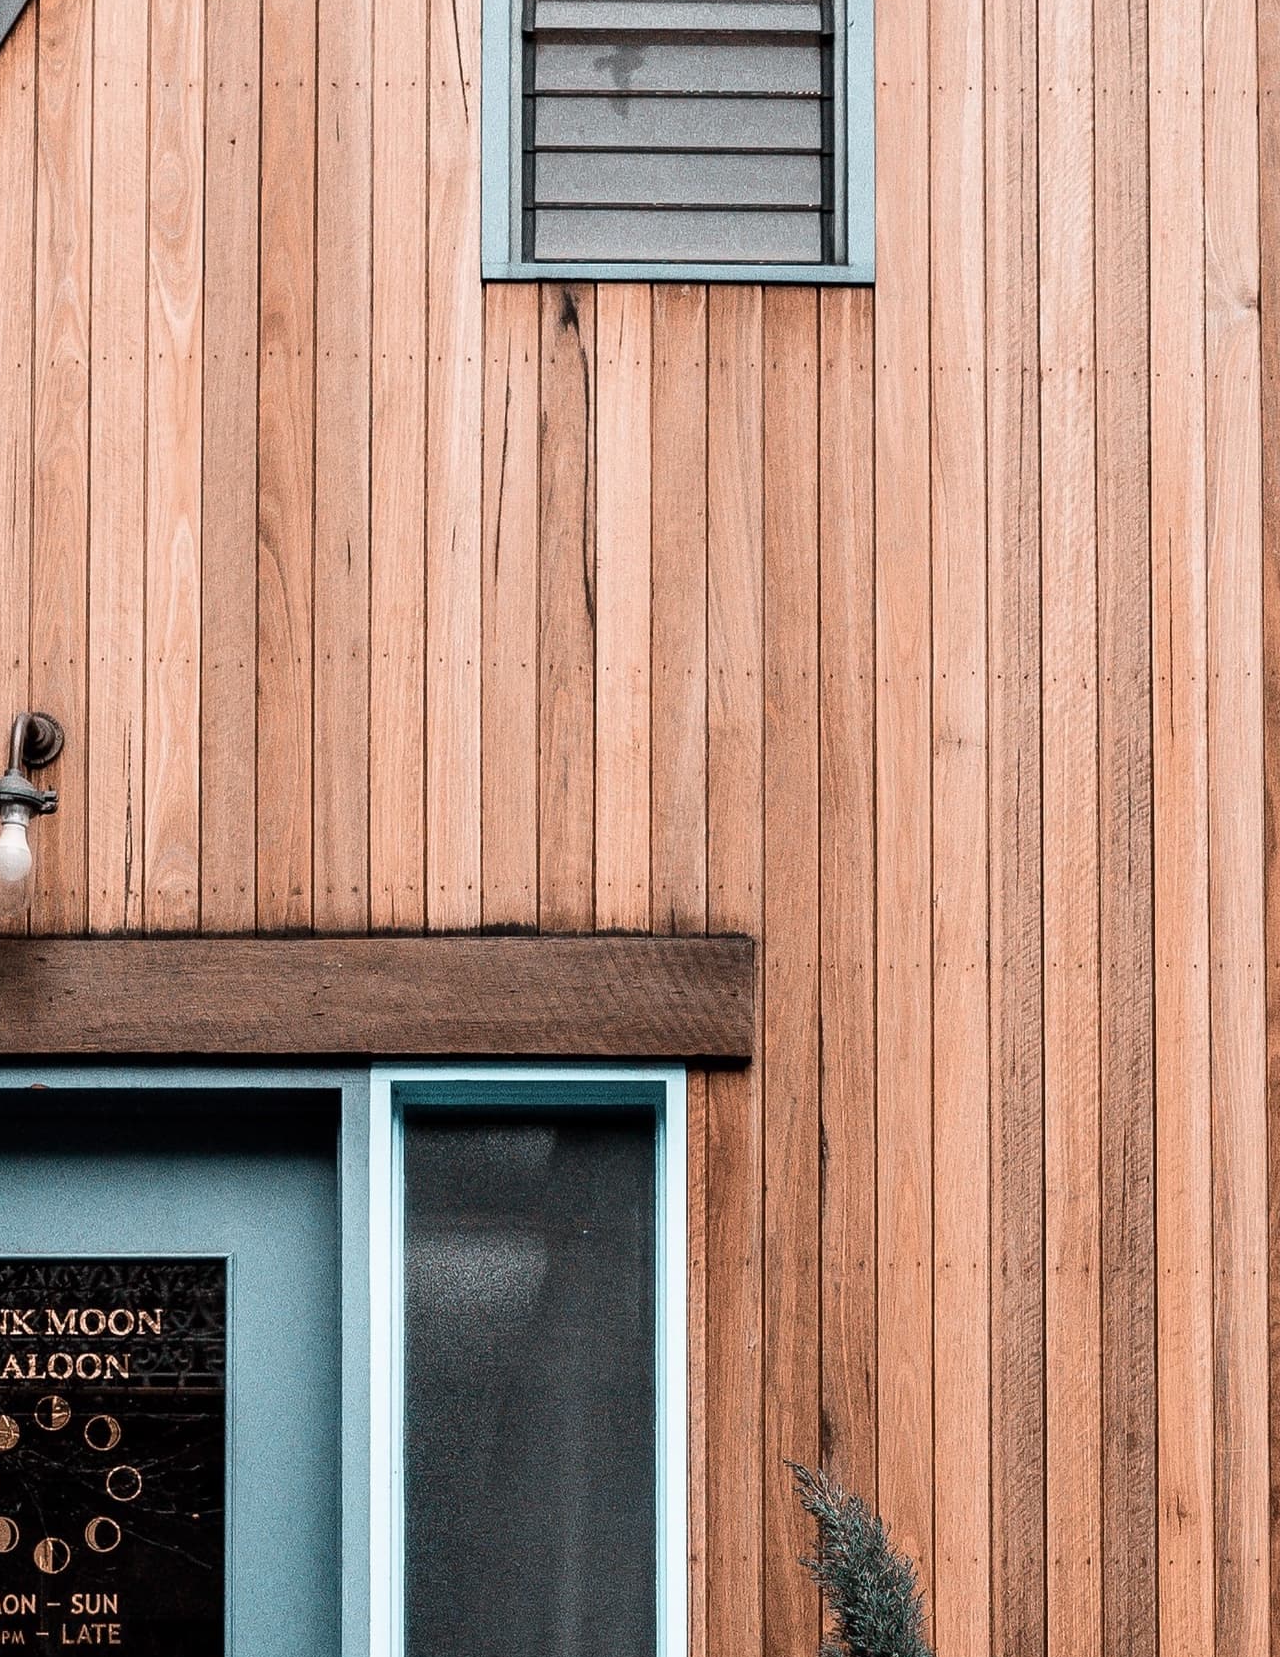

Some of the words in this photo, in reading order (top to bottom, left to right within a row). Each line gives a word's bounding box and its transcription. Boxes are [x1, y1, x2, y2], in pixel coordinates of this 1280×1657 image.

[44, 1309, 163, 1335] MOON
[71, 1593, 118, 1614] SUN
[62, 1623, 121, 1645] LATE
